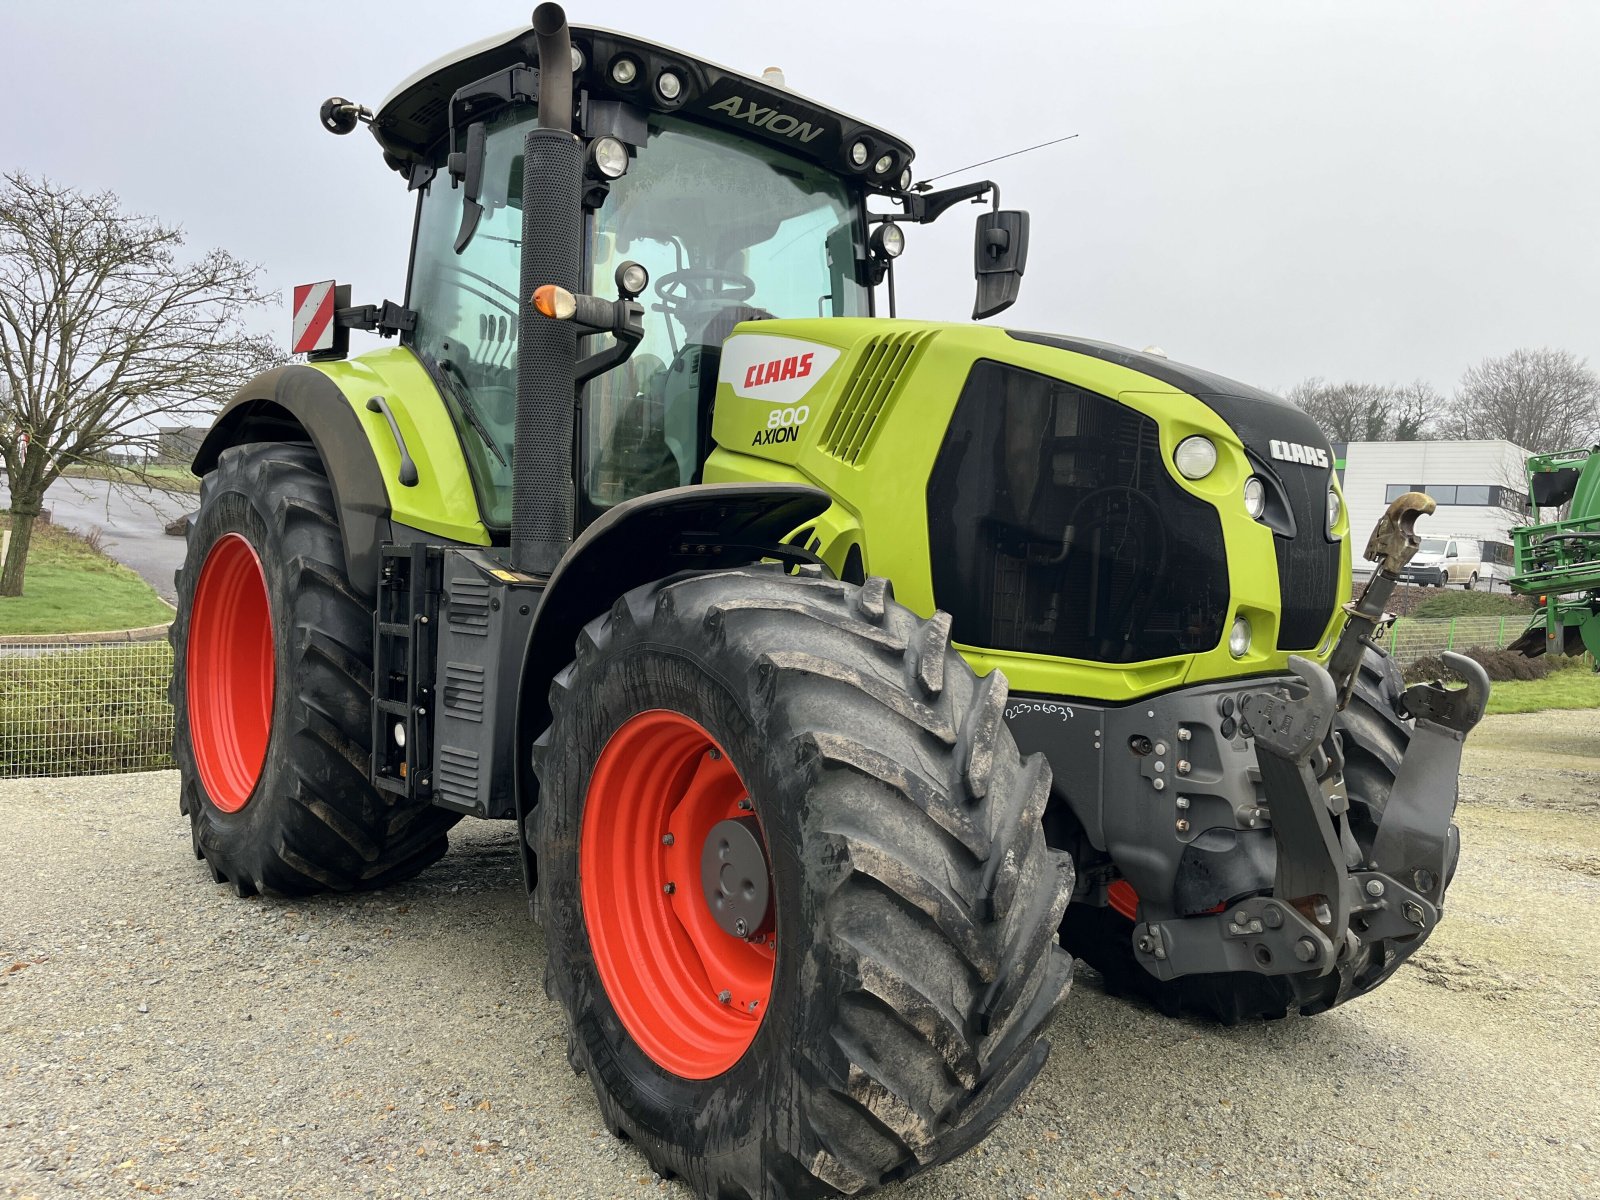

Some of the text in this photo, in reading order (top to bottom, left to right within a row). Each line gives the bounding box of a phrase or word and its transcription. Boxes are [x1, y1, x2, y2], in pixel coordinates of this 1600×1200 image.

[708, 95, 825, 143] AXION
[744, 352, 814, 388] CLAAS
[767, 405, 810, 429] 800
[752, 426, 799, 446] AXION
[1268, 439, 1329, 468] CLAAS
[1005, 703, 1074, 722] 22306039
